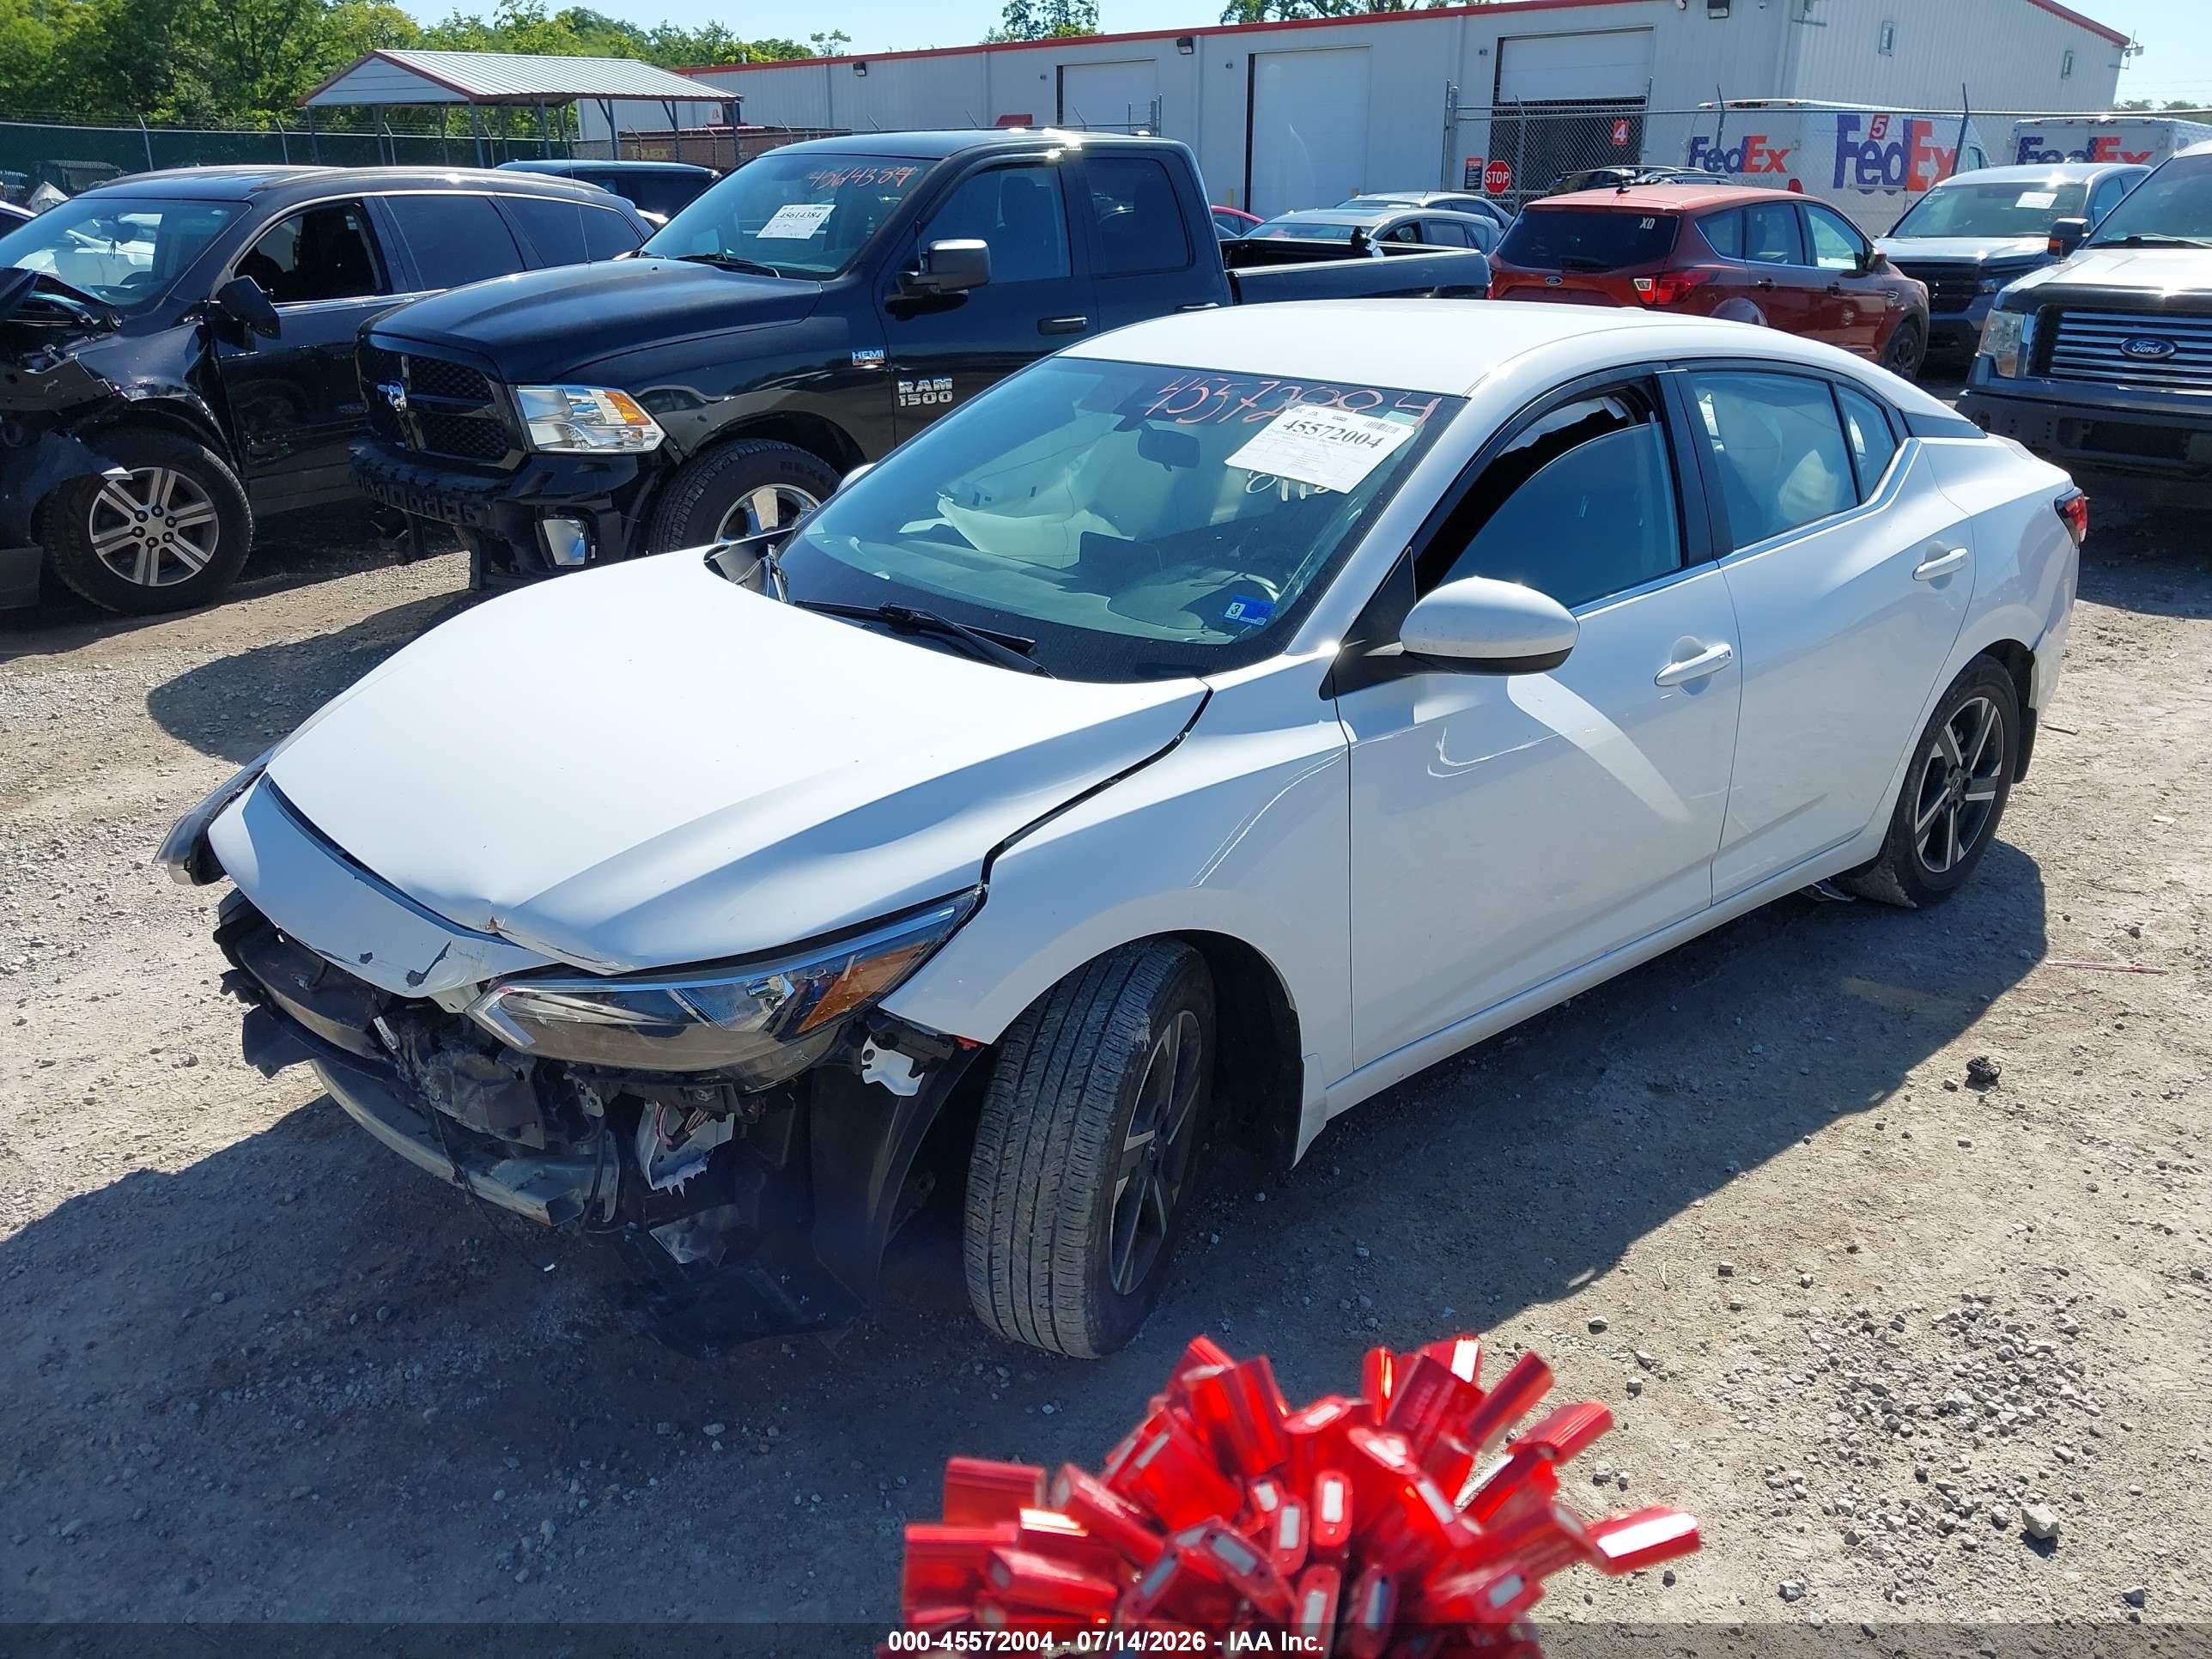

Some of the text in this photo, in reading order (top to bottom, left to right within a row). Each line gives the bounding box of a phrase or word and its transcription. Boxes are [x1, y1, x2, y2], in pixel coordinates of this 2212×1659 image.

[1614, 124, 1626, 142] 4
[1870, 118, 1886, 137] 5
[1688, 136, 1791, 173] FedEx
[1832, 114, 1956, 195] FedEx
[1486, 172, 1510, 184] STOP
[852, 349, 884, 360] HEMI
[2131, 341, 2163, 354] Ford
[898, 378, 953, 393] RAM
[898, 391, 953, 407] 1500
[1283, 419, 1386, 449] 45572004
